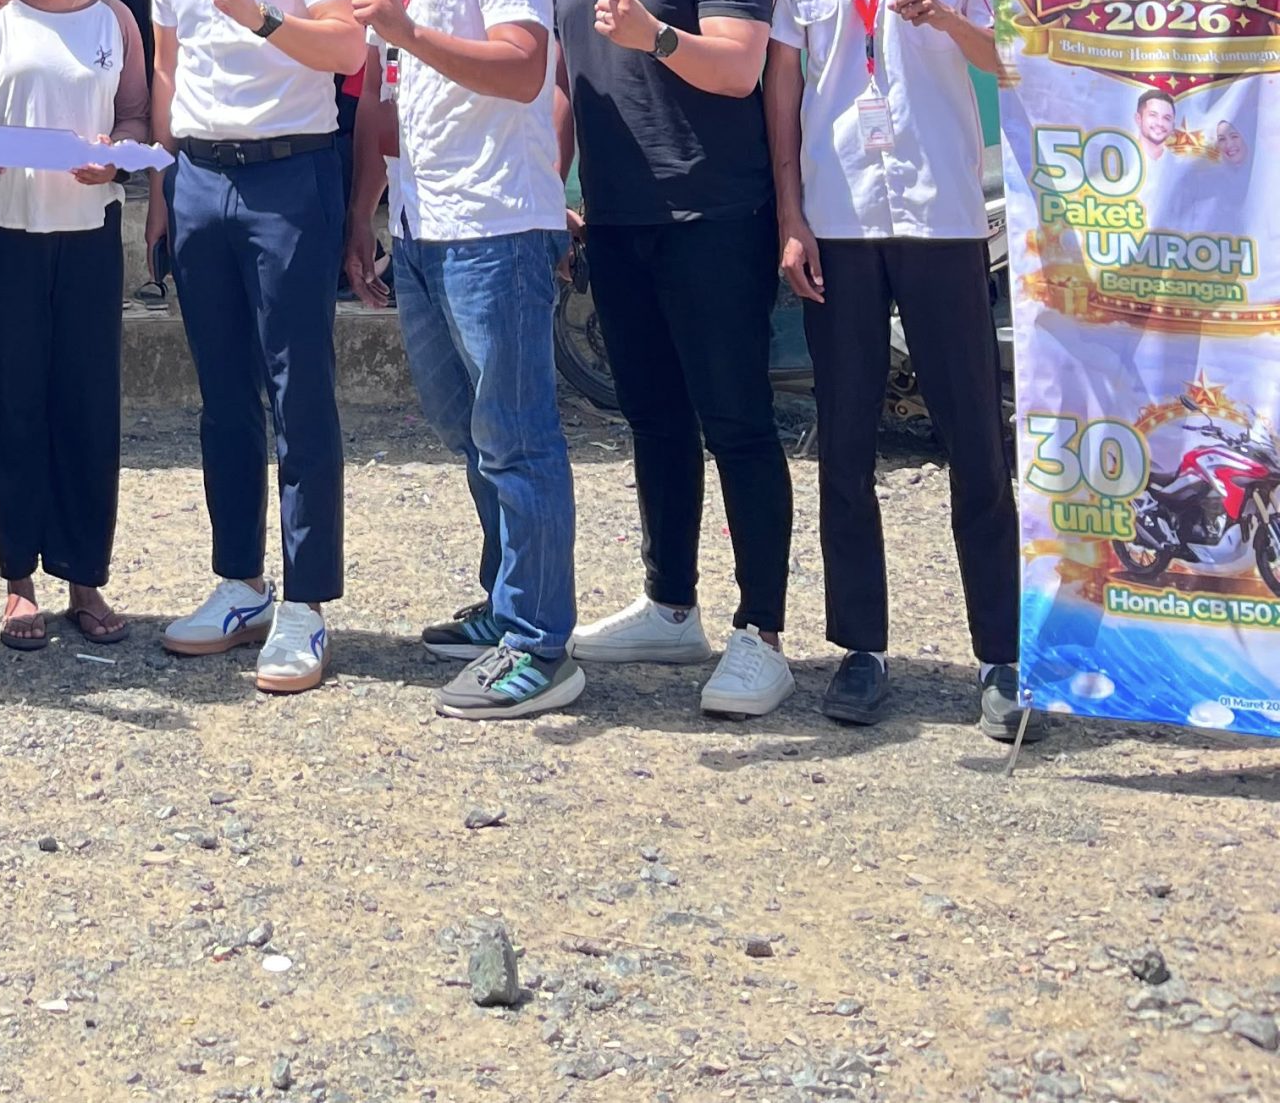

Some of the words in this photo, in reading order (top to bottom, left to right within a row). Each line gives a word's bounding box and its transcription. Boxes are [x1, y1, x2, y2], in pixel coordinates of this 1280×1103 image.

[1105, 1, 1231, 33] 2026
[1060, 39, 1085, 54] Beli
[1087, 45, 1124, 58] motor
[1128, 47, 1170, 61] Honda
[1172, 49, 1220, 64] banyak
[1032, 128, 1143, 197] 50
[1041, 196, 1144, 229] Paket
[1087, 230, 1254, 275] UMROH
[1101, 270, 1243, 301] Berpasangan
[1026, 414, 1147, 498] 30
[1052, 498, 1133, 536] unit
[1109, 589, 1190, 617] Honda
[1233, 698, 1265, 710] Maret
